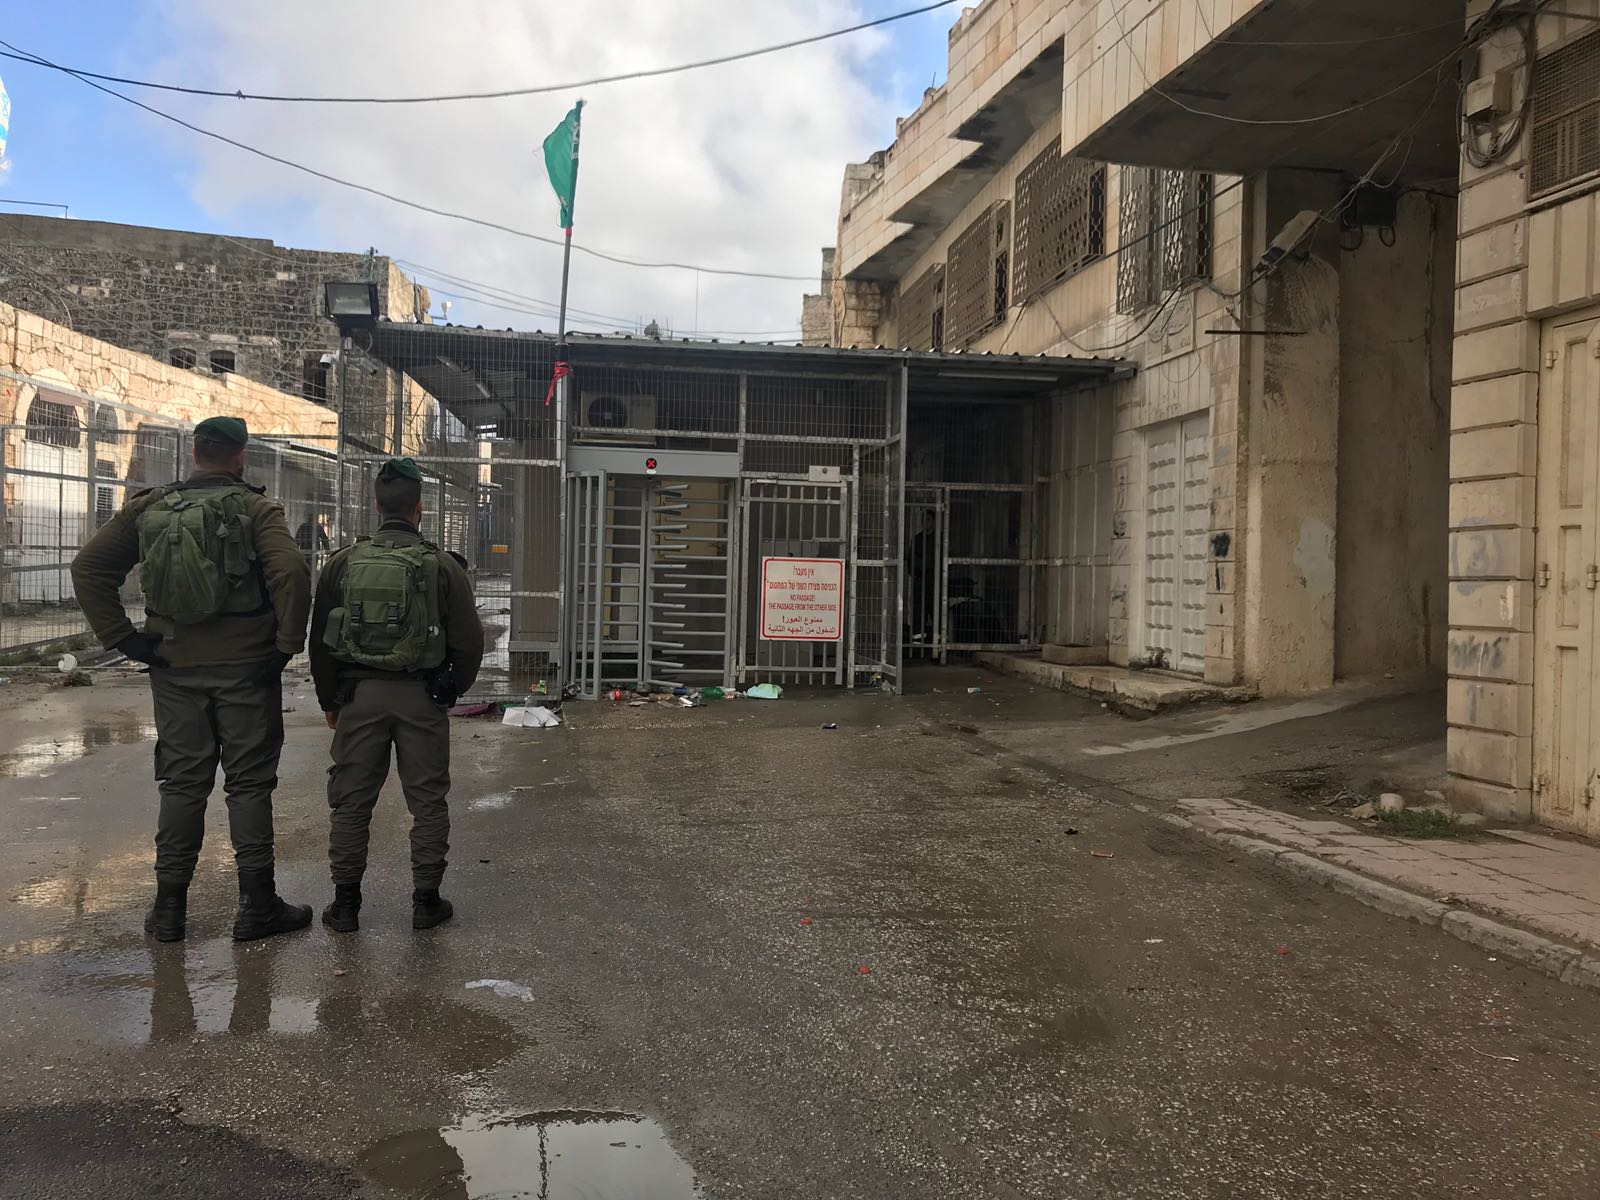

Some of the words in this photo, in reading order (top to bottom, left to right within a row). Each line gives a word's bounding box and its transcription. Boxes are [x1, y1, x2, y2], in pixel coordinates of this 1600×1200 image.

[793, 565, 807, 577] מעבר!
[807, 568, 815, 578] אין
[789, 579, 795, 590] של
[821, 583, 837, 591] הכניסה
[776, 602, 794, 610] PASSAGE
[806, 603, 814, 611] THE
[804, 616, 823, 625] ممنوع
[805, 627, 815, 635] من
[815, 626, 836, 635] الدخول
